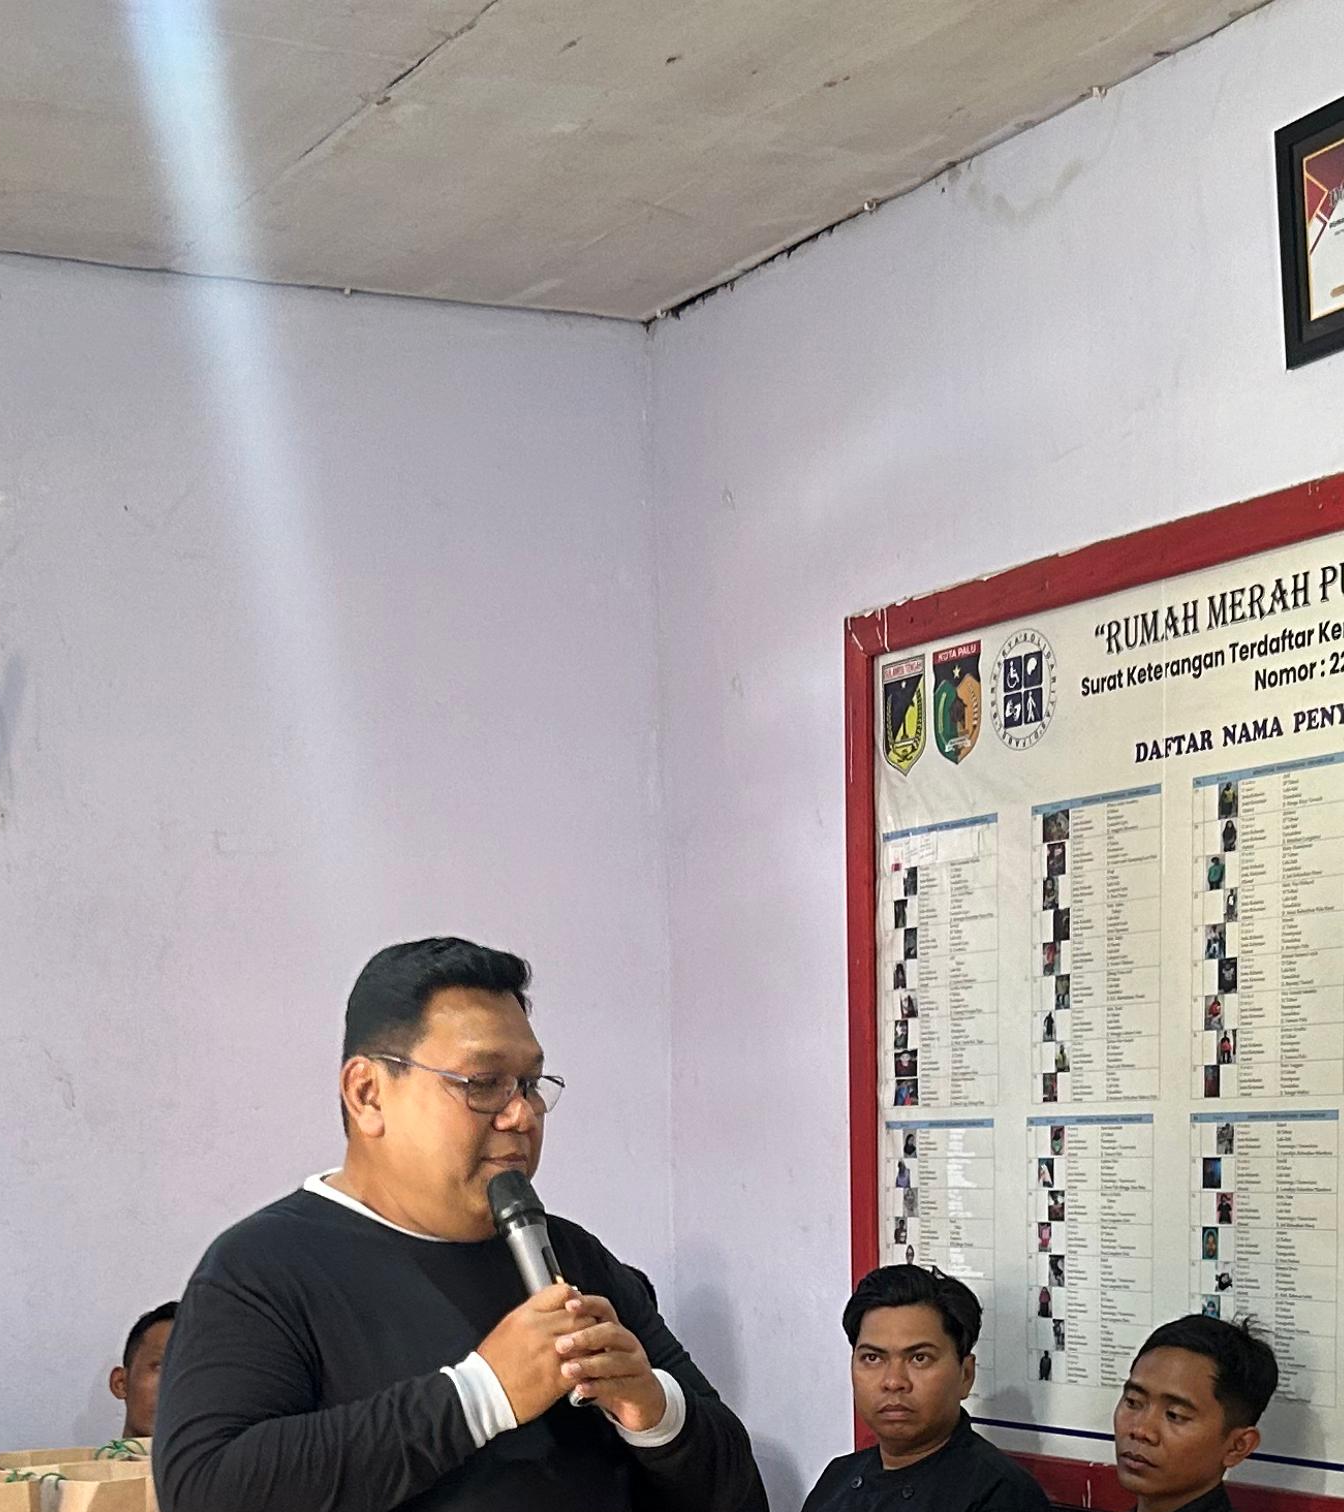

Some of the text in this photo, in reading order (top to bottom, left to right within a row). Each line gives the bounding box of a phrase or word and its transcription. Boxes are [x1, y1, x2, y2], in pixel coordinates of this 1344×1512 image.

[1207, 571, 1312, 631] MERAH
[938, 643, 977, 663] KOTA PALU
[1081, 668, 1123, 697] Surat
[1127, 649, 1225, 687] Keterangan
[1229, 627, 1315, 664] Terdaftar
[1254, 656, 1316, 691] Nomor
[1134, 730, 1214, 763] DAFTAR
[1222, 716, 1283, 748] NAMA
